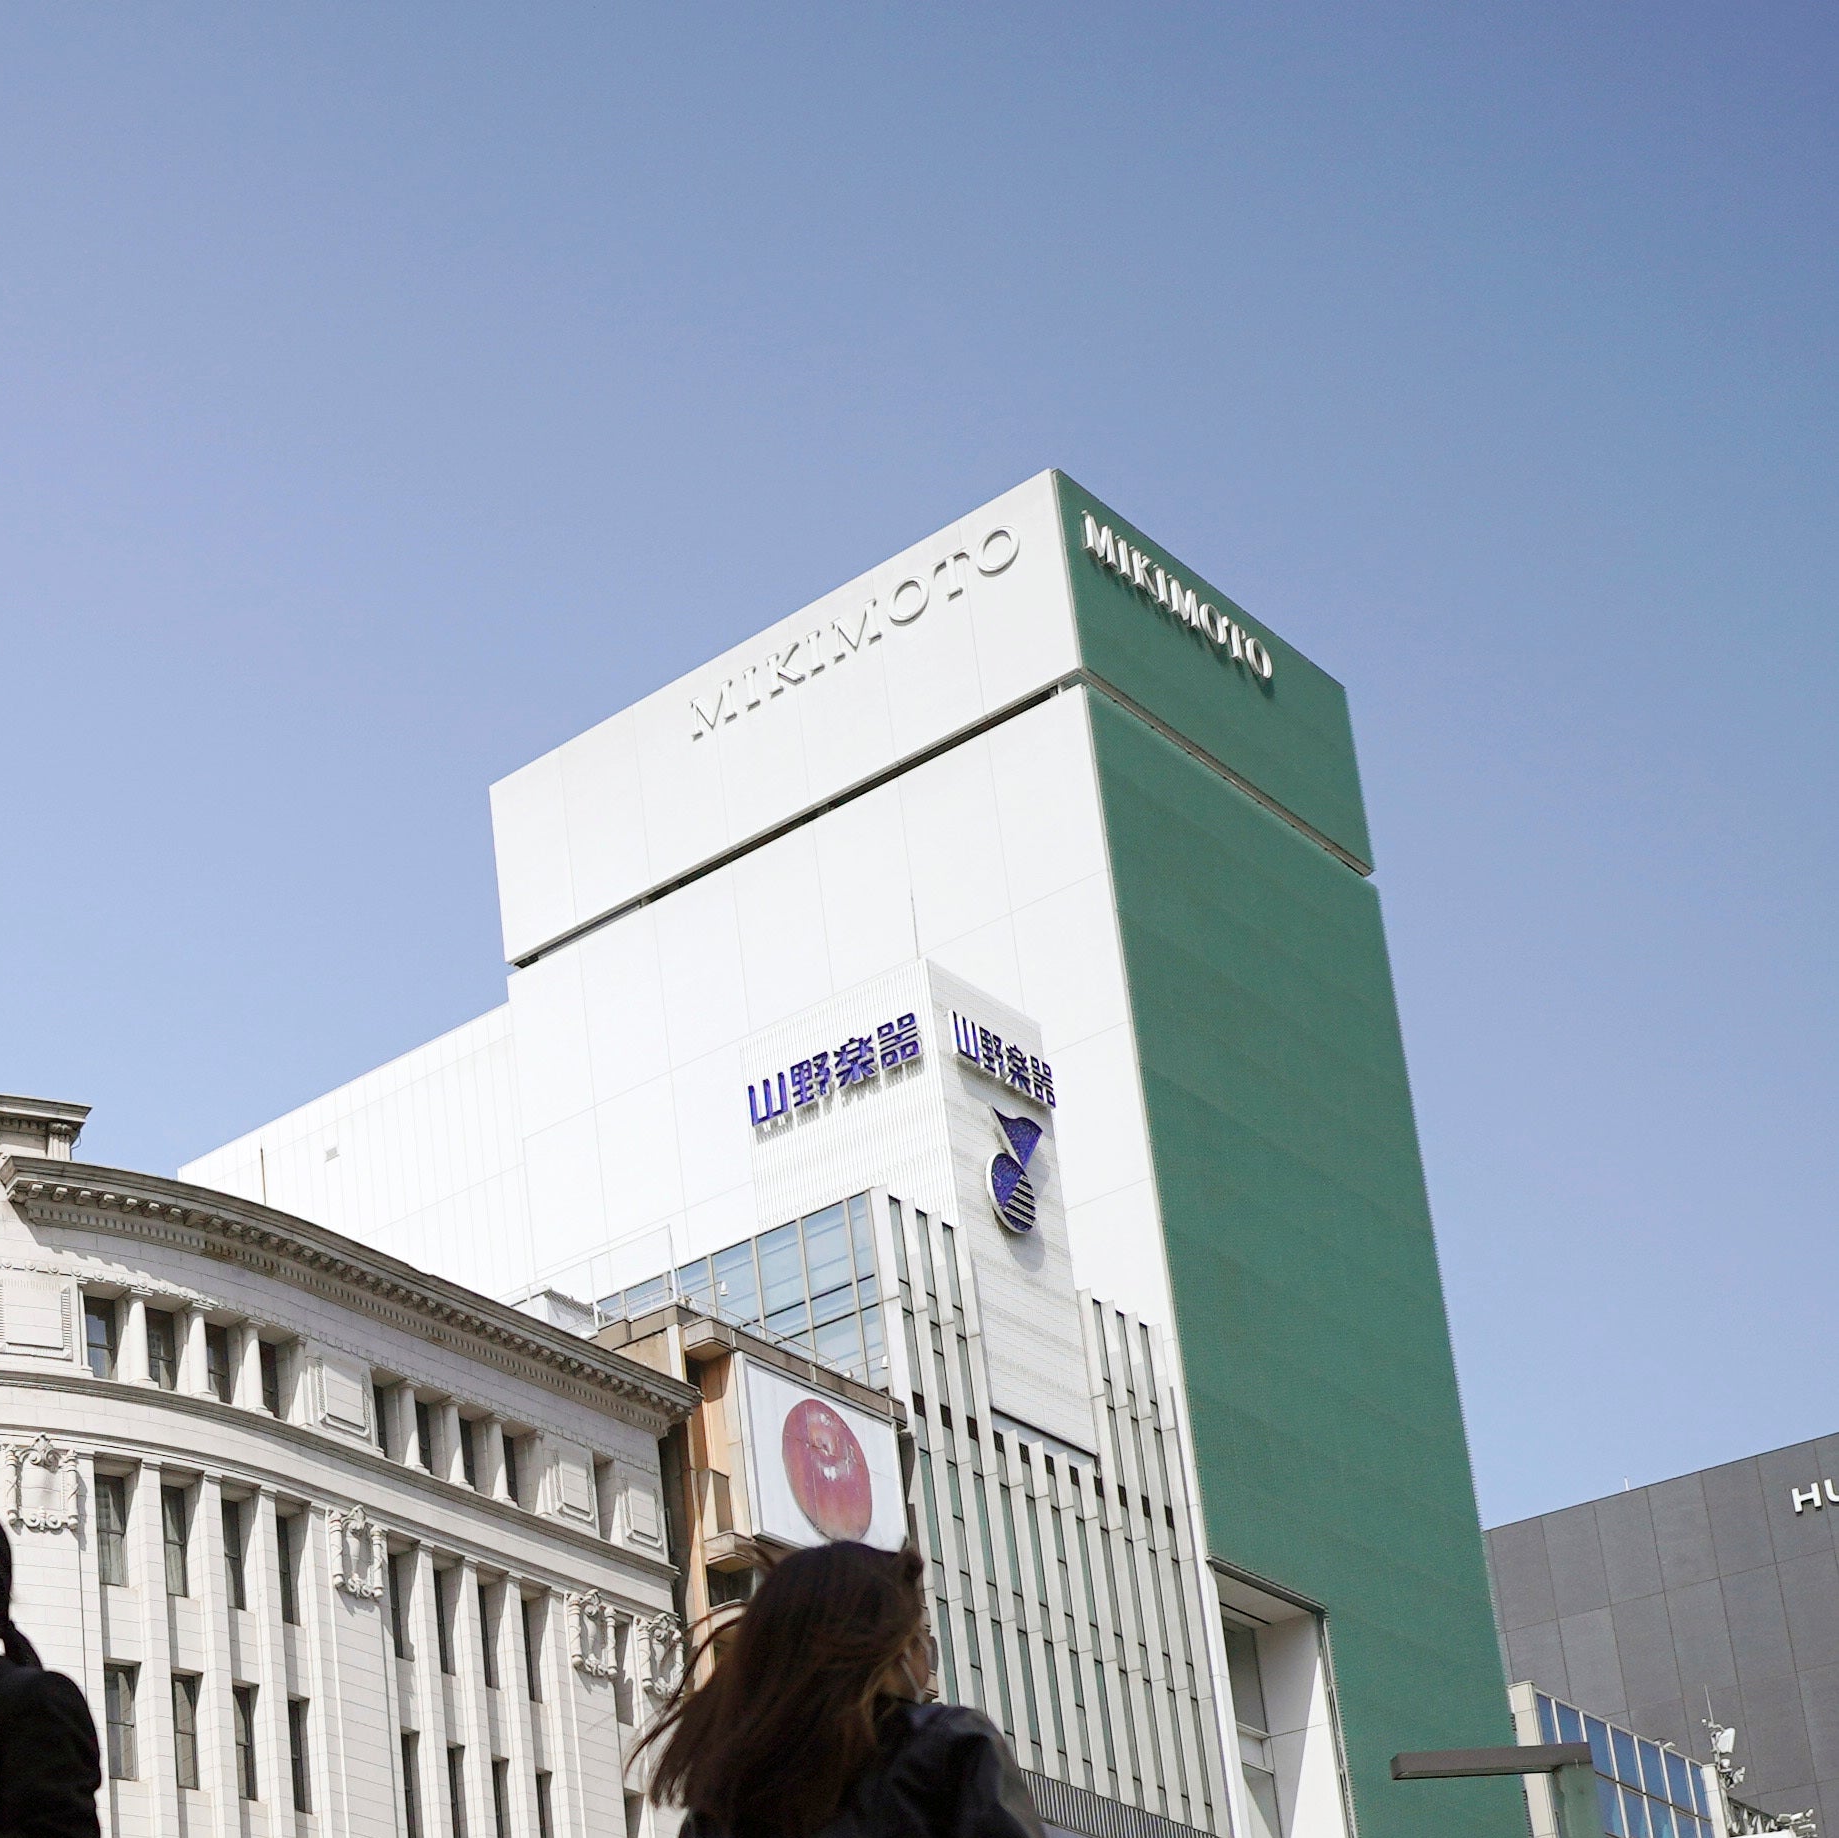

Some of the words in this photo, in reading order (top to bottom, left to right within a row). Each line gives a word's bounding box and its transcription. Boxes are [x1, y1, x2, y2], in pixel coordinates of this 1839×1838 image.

[690, 525, 1020, 741] MIKIMOTO
[1082, 510, 1273, 680] MIKIMOTO
[748, 1012, 920, 1127] 山野楽器
[950, 1009, 1056, 1109] 山野楽器
